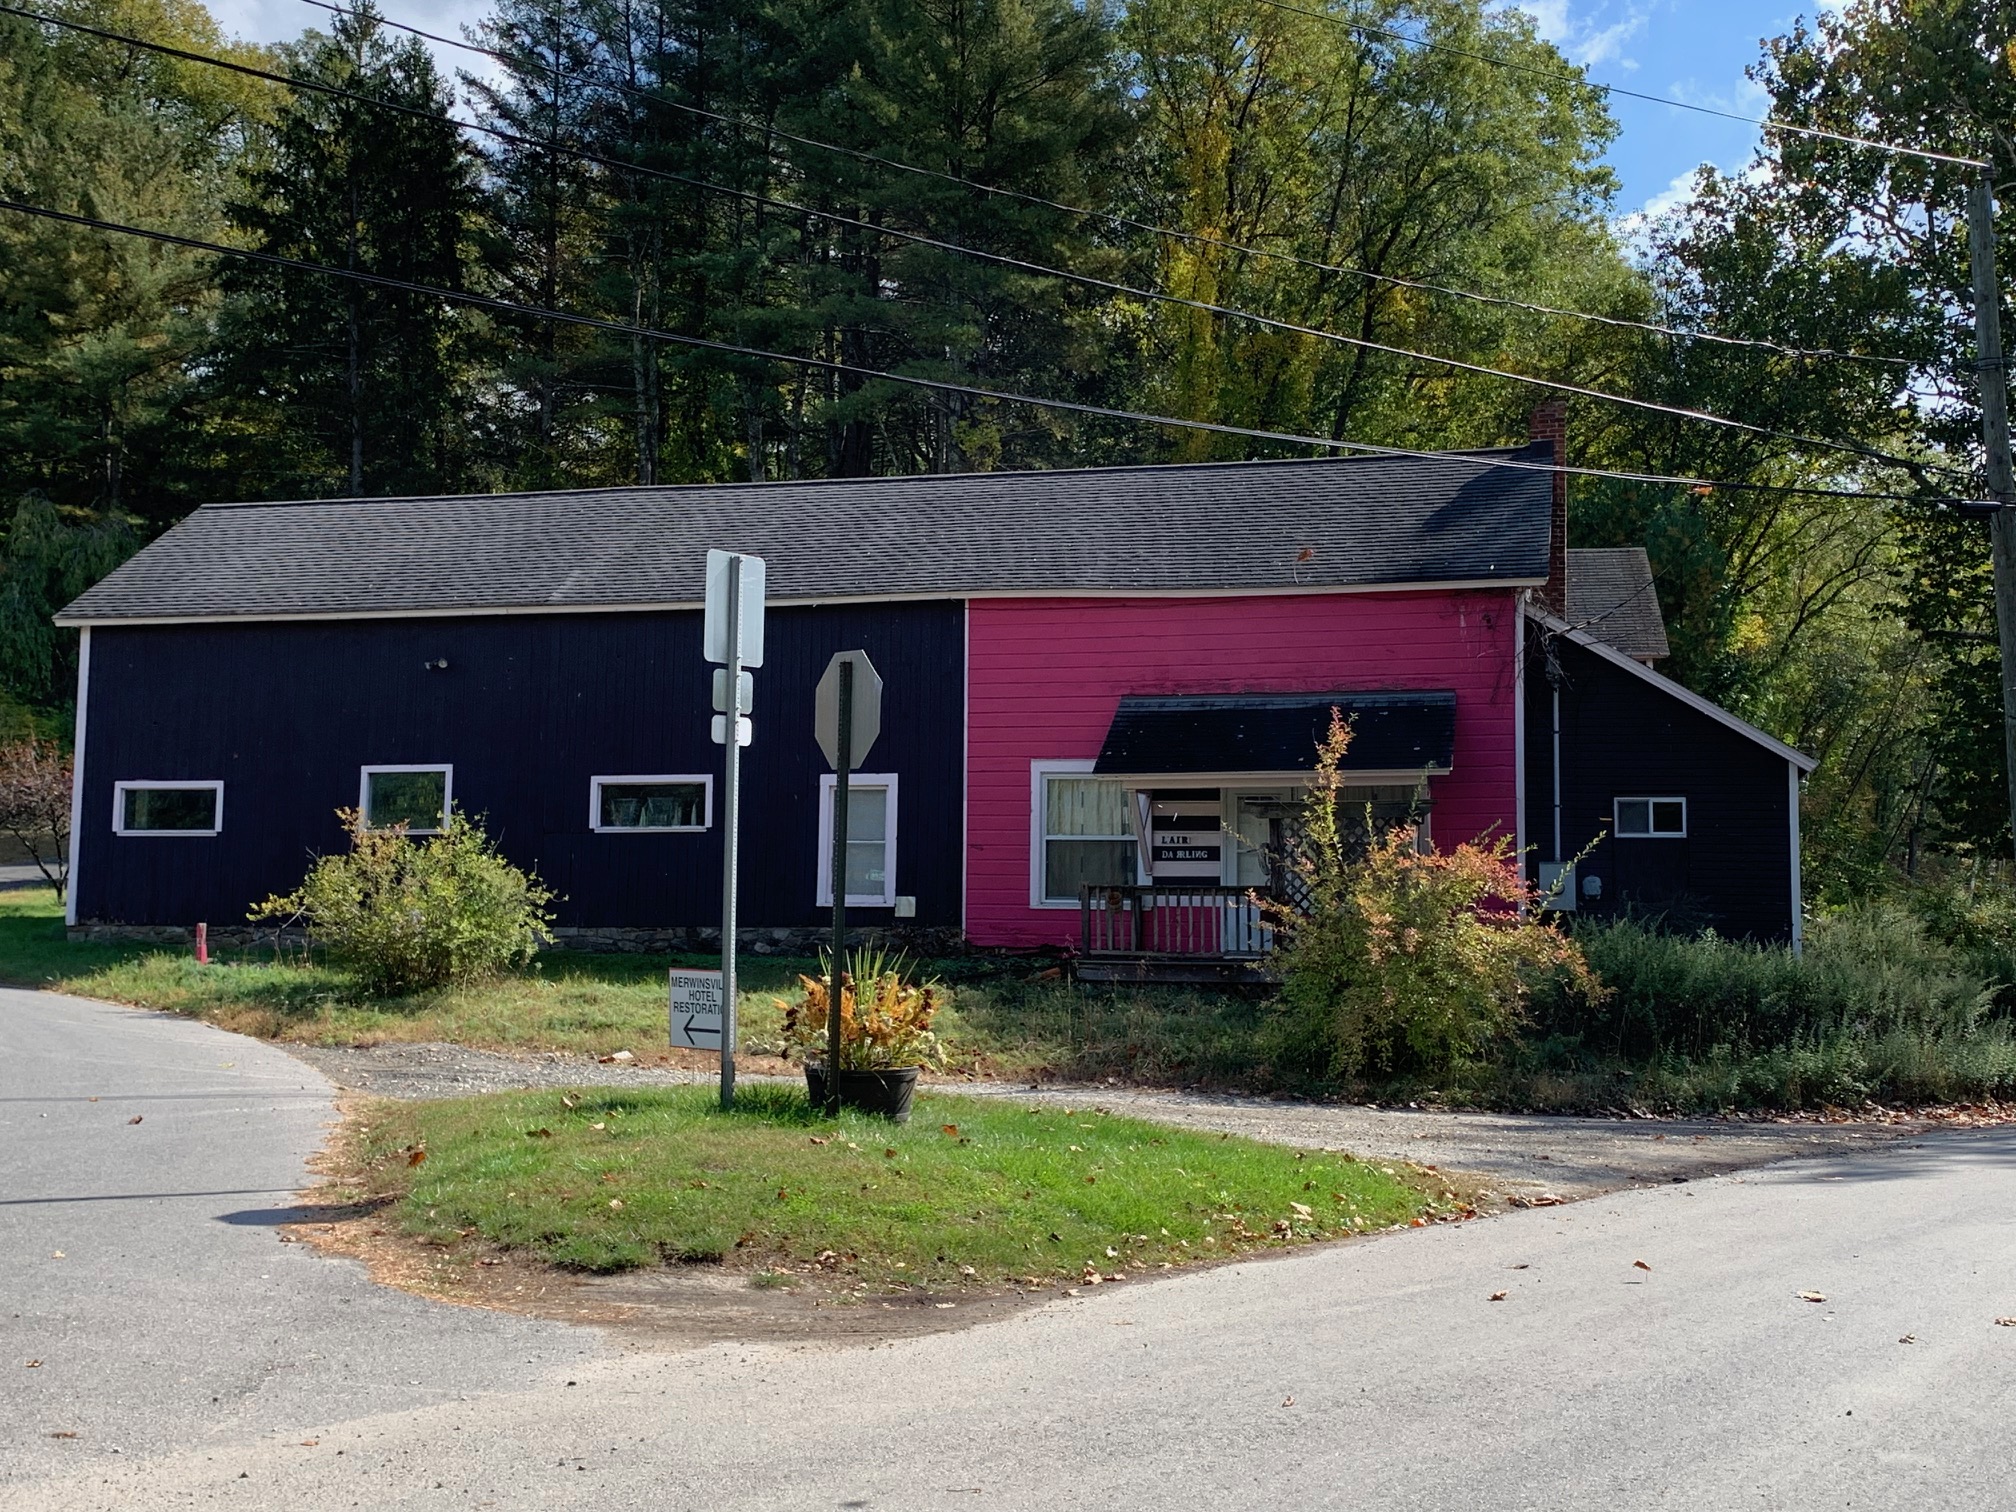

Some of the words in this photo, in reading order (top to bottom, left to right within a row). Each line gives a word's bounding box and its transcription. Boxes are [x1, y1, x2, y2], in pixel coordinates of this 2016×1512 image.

[671, 976, 723, 990] MERWINSVIL
[688, 990, 717, 1003] HOTEL
[673, 1001, 723, 1015] RESTORATI
